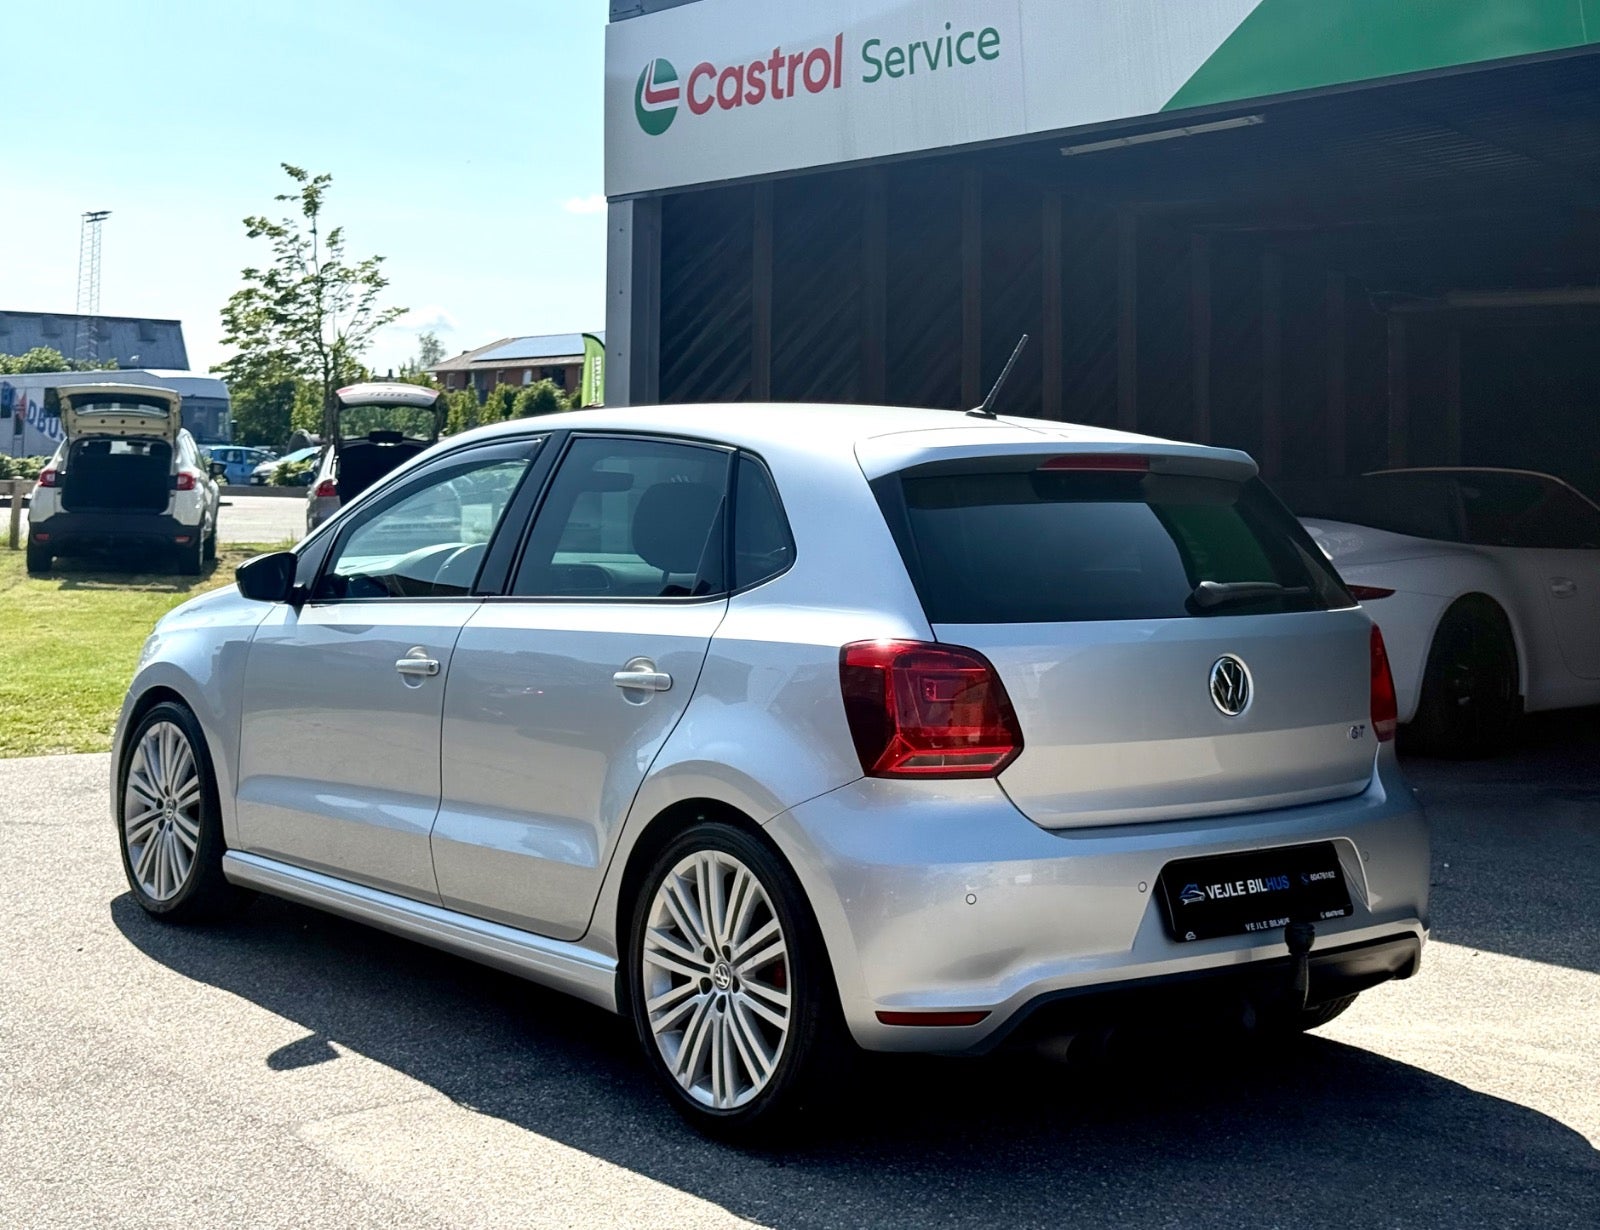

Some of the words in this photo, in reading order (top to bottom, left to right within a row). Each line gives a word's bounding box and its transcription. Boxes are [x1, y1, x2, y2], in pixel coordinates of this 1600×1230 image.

[686, 32, 844, 116] Castrol
[861, 22, 1001, 84] Service
[1205, 881, 1246, 899] VEJLE
[1247, 875, 1289, 893] BILHUS
[1245, 921, 1268, 931] VEJLE
